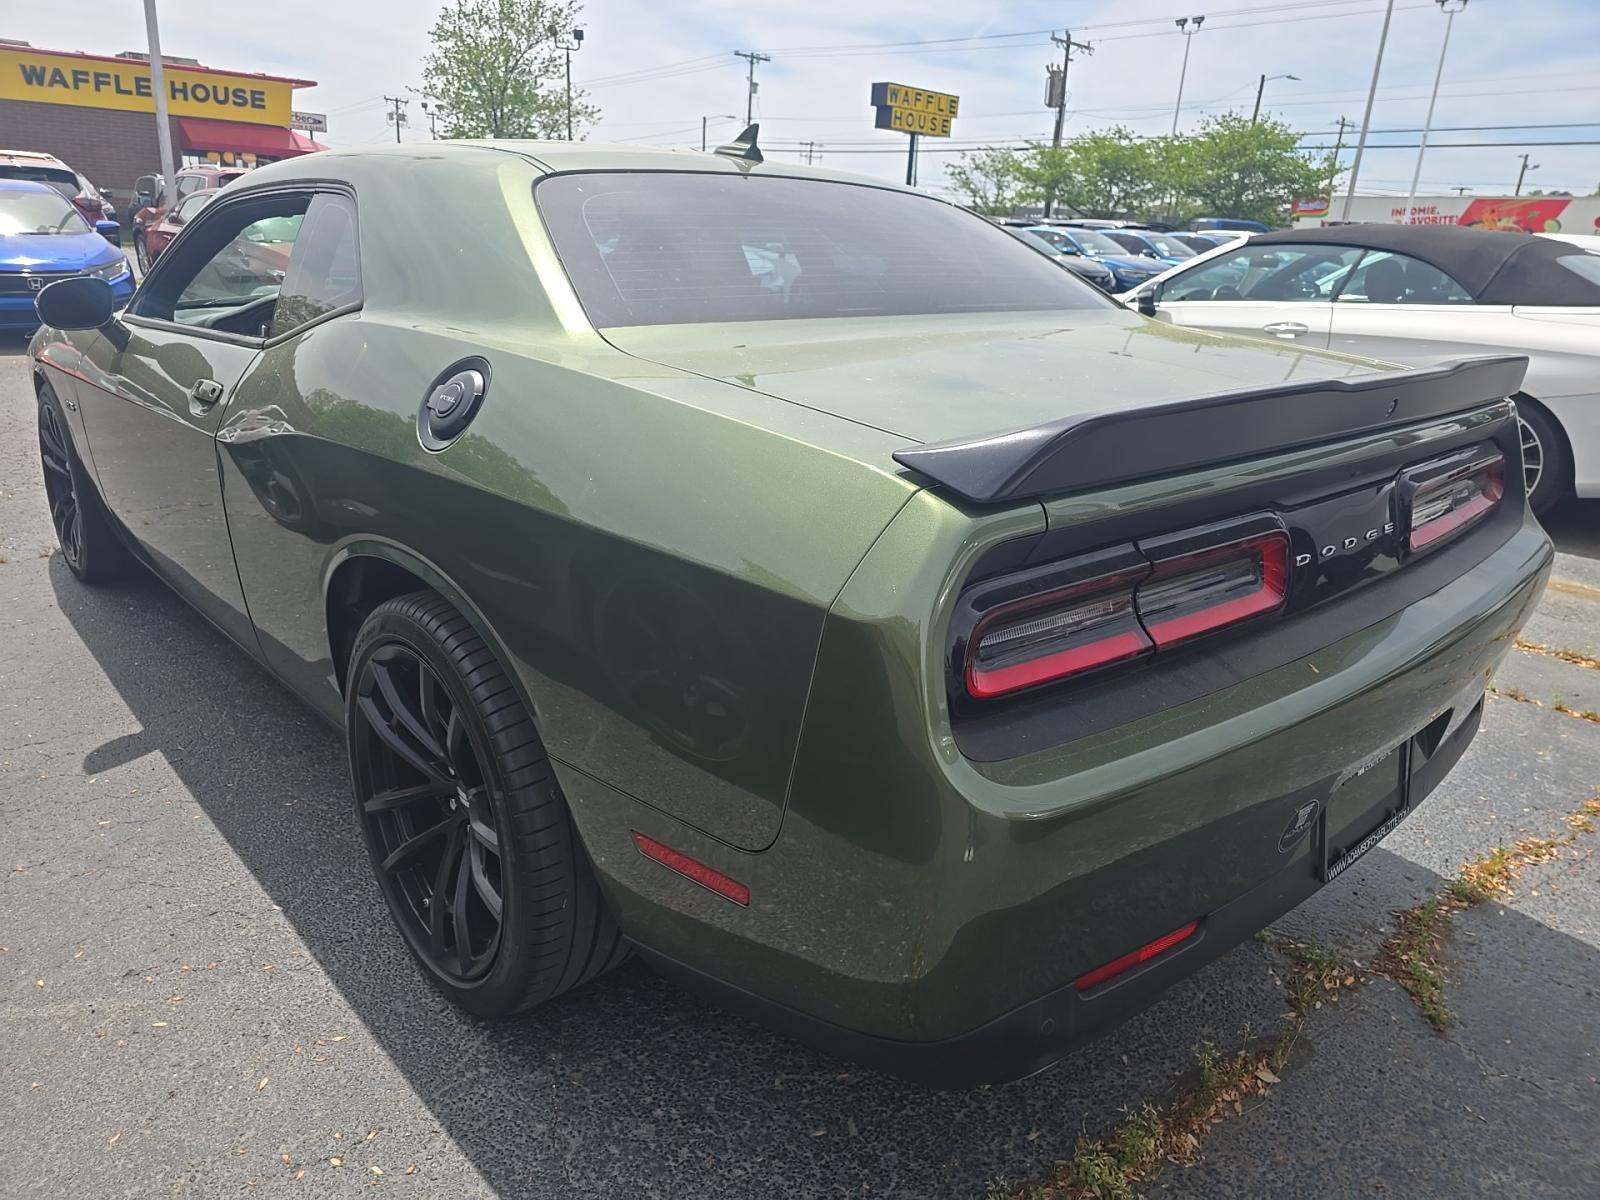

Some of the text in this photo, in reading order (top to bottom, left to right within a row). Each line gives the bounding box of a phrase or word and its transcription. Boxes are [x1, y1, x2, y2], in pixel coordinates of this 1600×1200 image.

[19, 63, 266, 109] WAFFLE HOUSE
[889, 87, 957, 115] WAFFLE
[893, 109, 950, 134] HOUSE
[1295, 522, 1395, 567] DODGE
